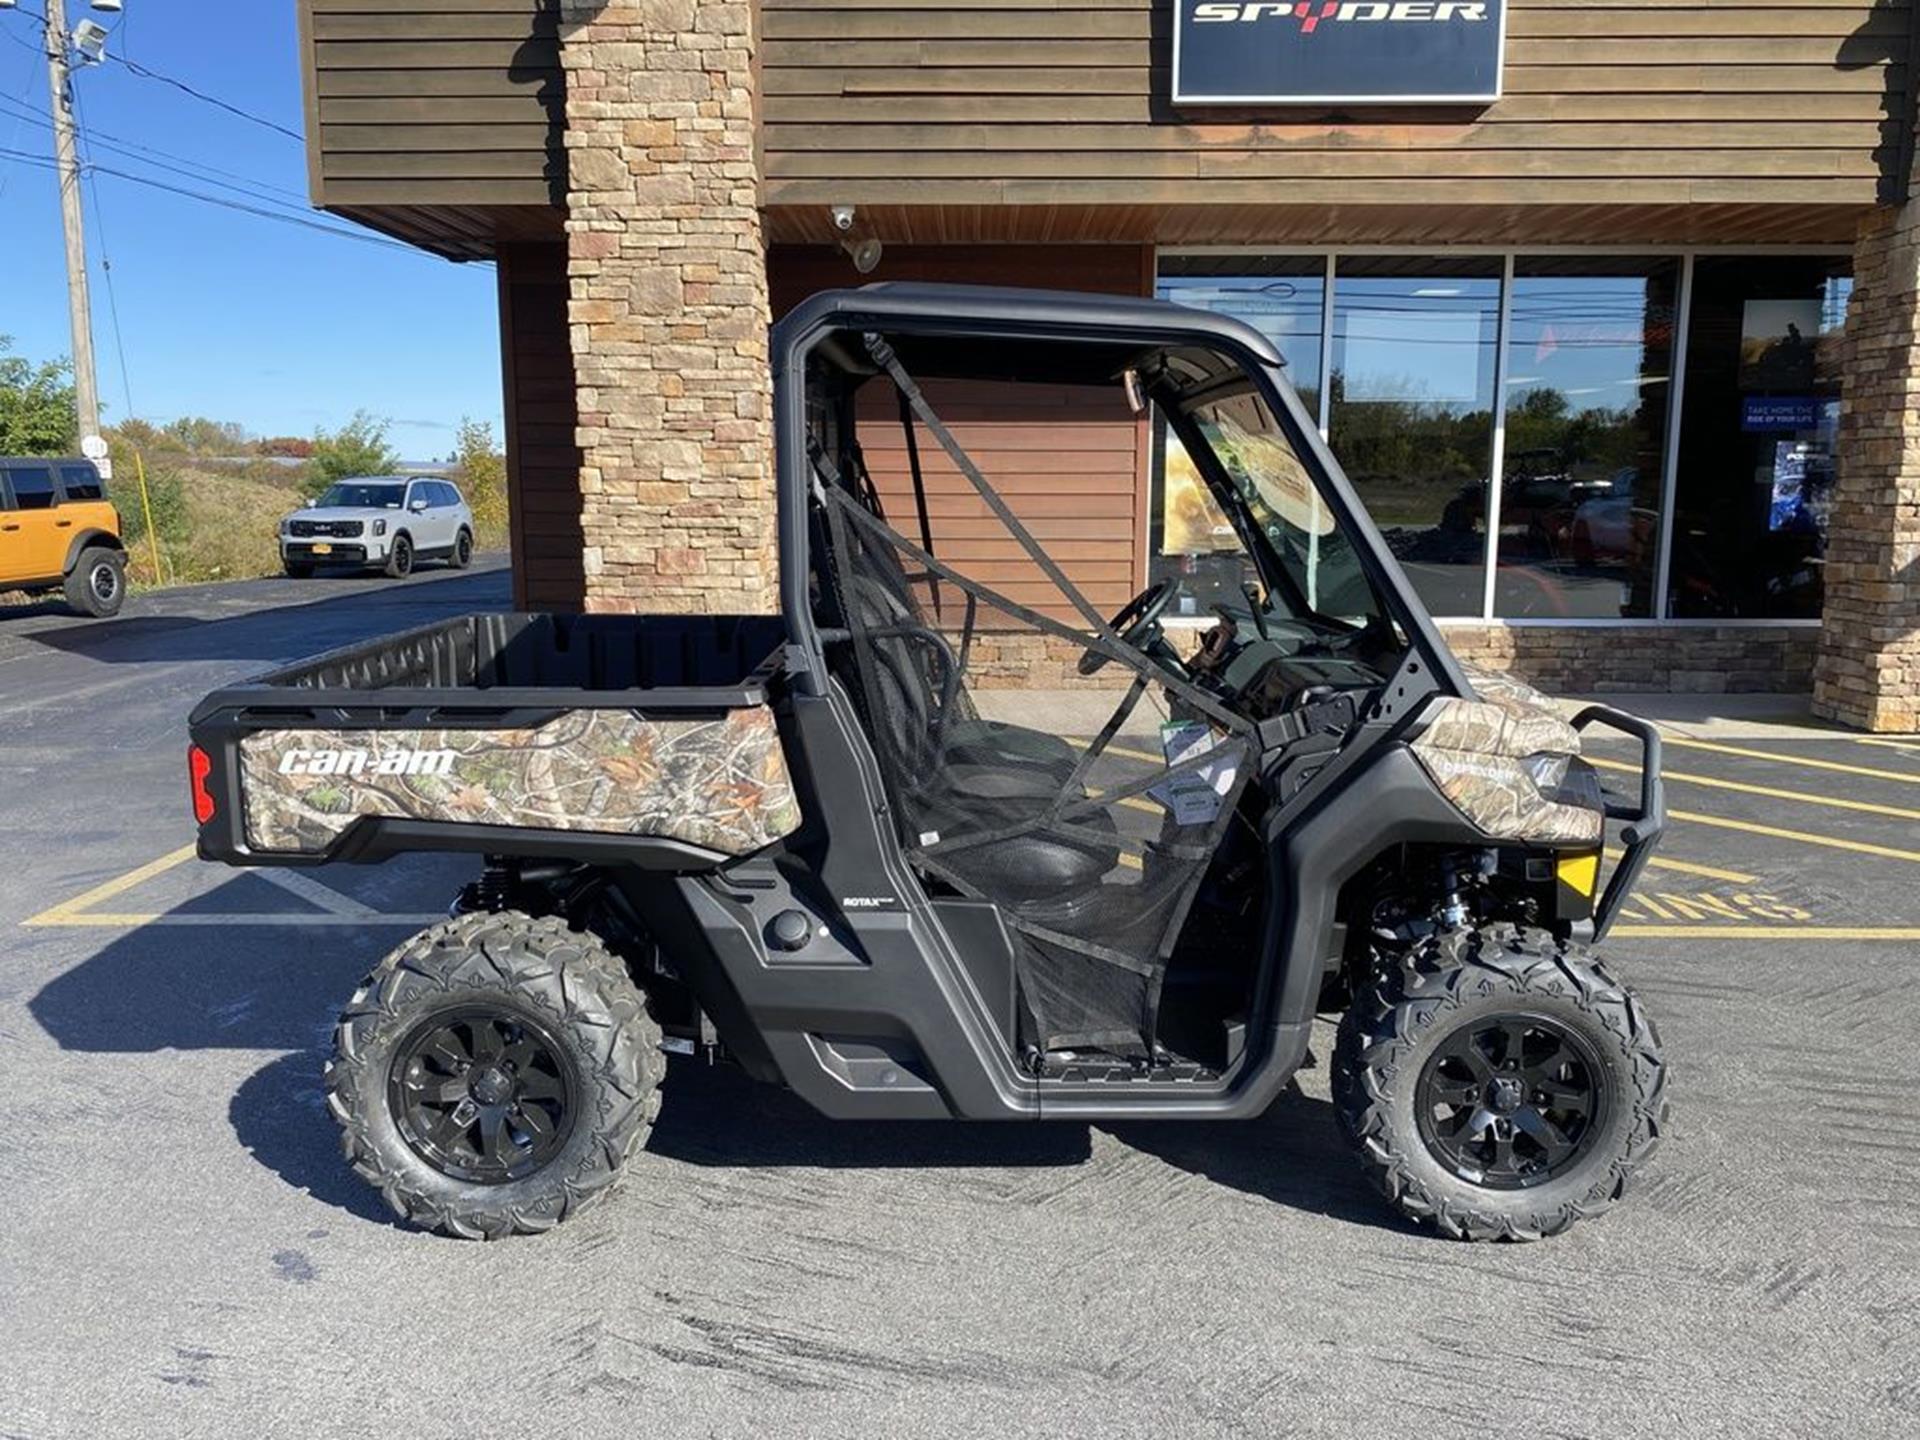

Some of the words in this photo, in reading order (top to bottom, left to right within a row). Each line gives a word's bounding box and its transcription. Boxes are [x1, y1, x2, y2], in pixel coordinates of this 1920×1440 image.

[1192, 2, 1487, 33] SPYDER
[1771, 406, 1793, 414] HOME
[1777, 415, 1795, 423] YOUR
[278, 748, 455, 775] can-am
[843, 897, 880, 907] ROTAX
